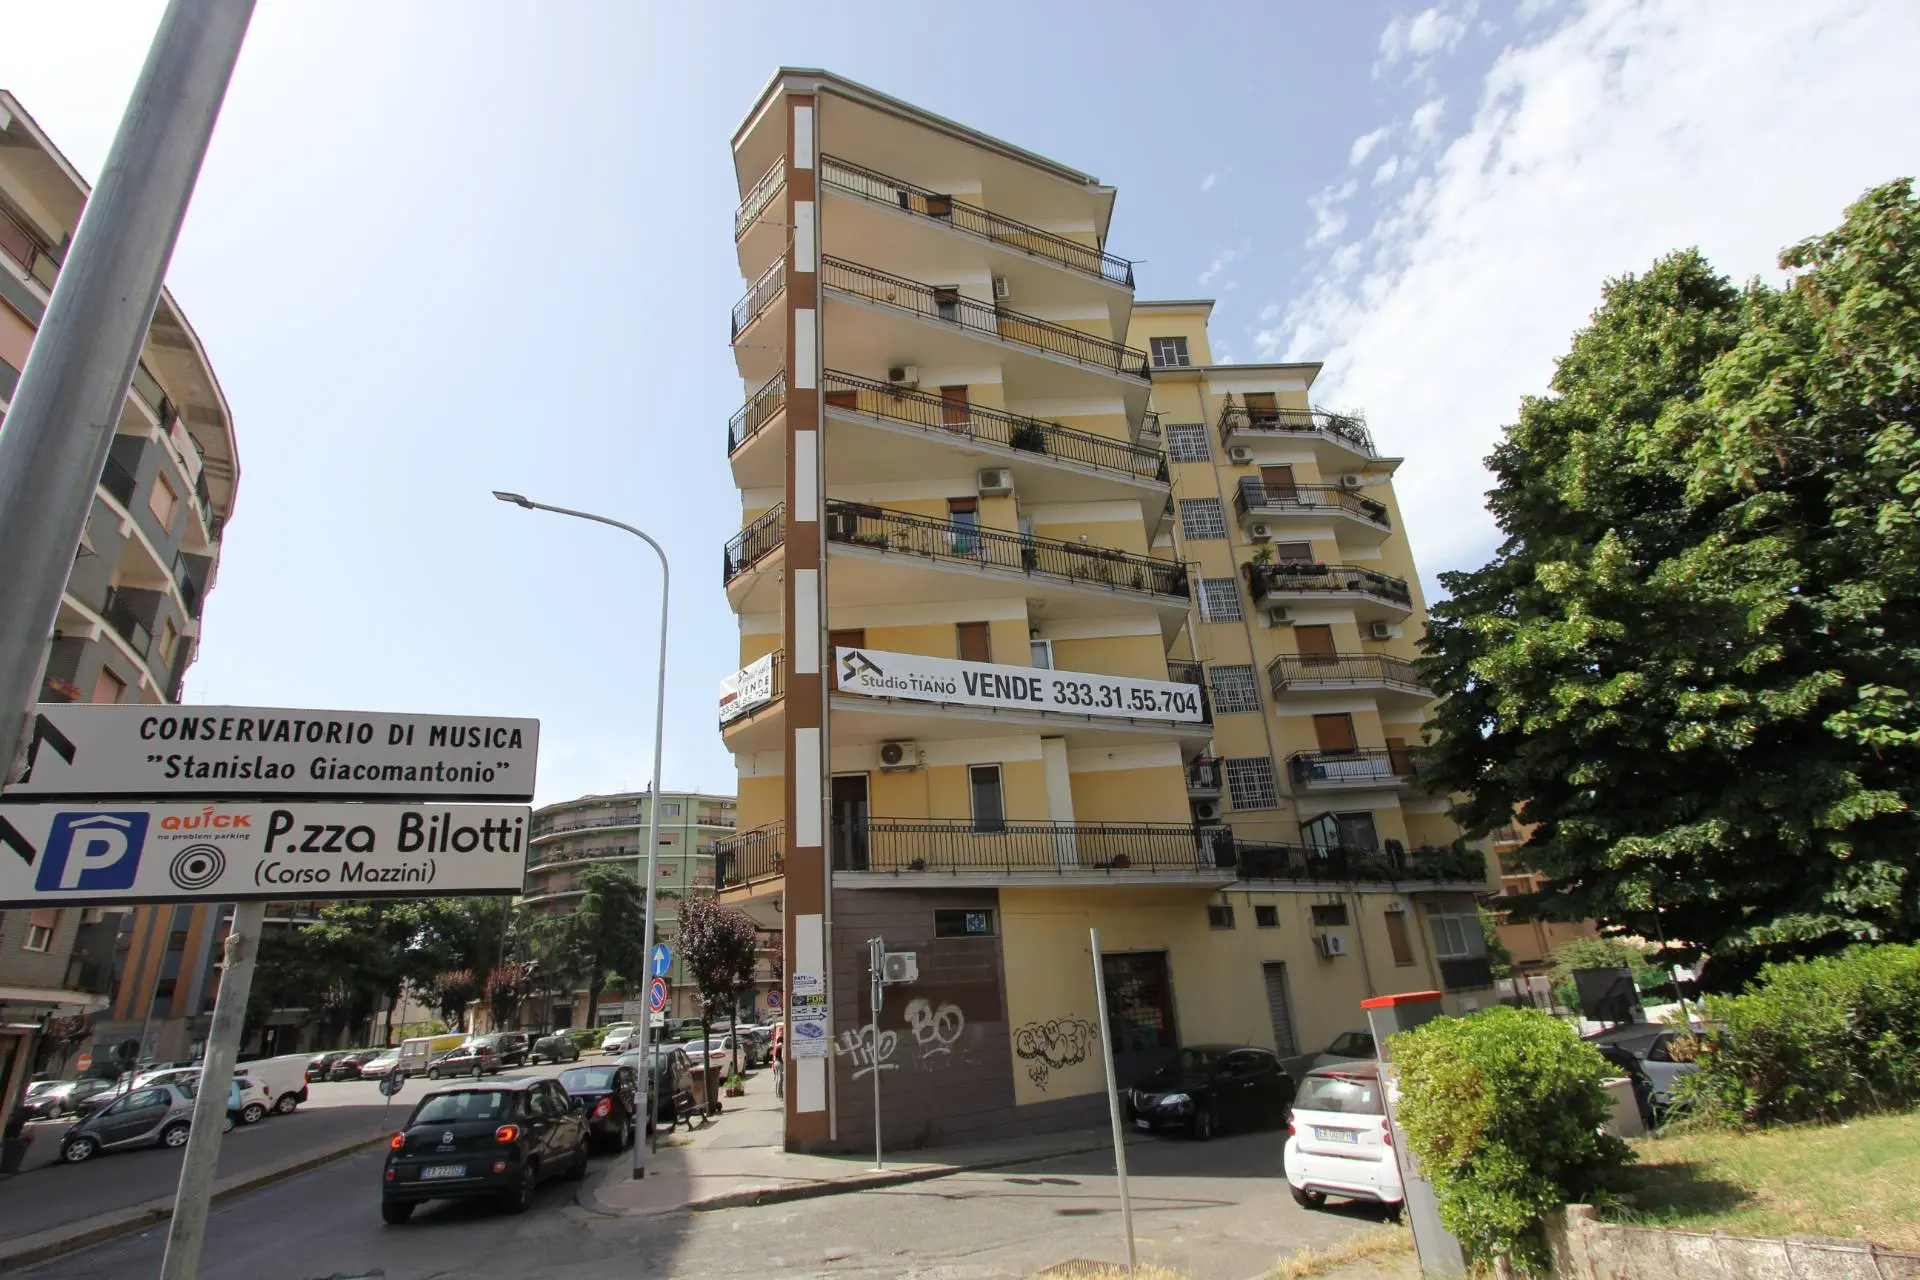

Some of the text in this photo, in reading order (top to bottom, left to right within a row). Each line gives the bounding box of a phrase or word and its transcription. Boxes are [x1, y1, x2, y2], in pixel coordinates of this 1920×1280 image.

[738, 675, 769, 698] VENDE
[861, 675, 908, 690] Studio
[910, 679, 956, 695] TIANO
[962, 670, 1198, 714] VENDE 333.31.55.704
[140, 716, 523, 750] CONSERVATORIO DI MUSICA
[172, 832, 213, 841] problem
[214, 832, 251, 841] parking
[263, 809, 524, 854] P.zza Bilotti
[59, 827, 129, 889] P
[254, 857, 437, 887] (Corso Mazzini)
